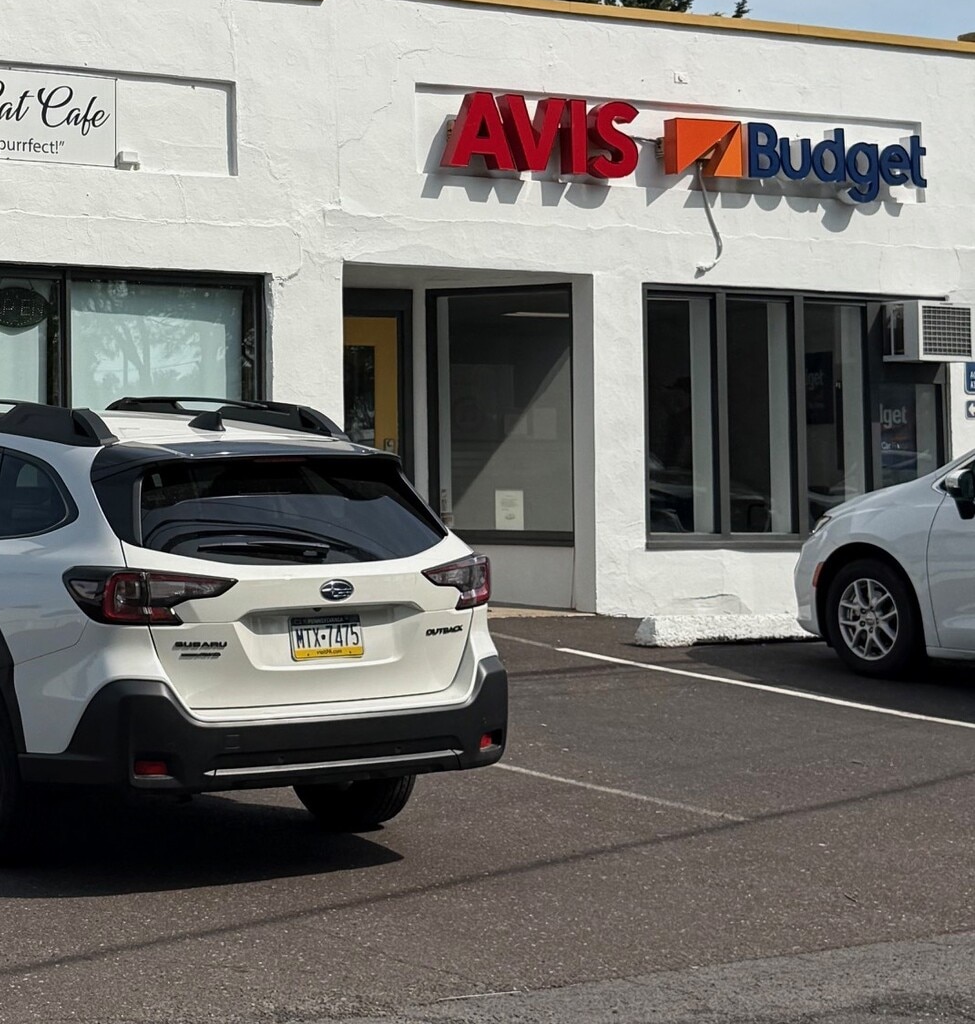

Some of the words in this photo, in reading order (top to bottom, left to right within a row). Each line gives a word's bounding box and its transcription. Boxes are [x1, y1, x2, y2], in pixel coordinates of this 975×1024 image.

[37, 85, 111, 137] Cafe
[440, 91, 640, 179] AVIS
[747, 121, 928, 203] Budget
